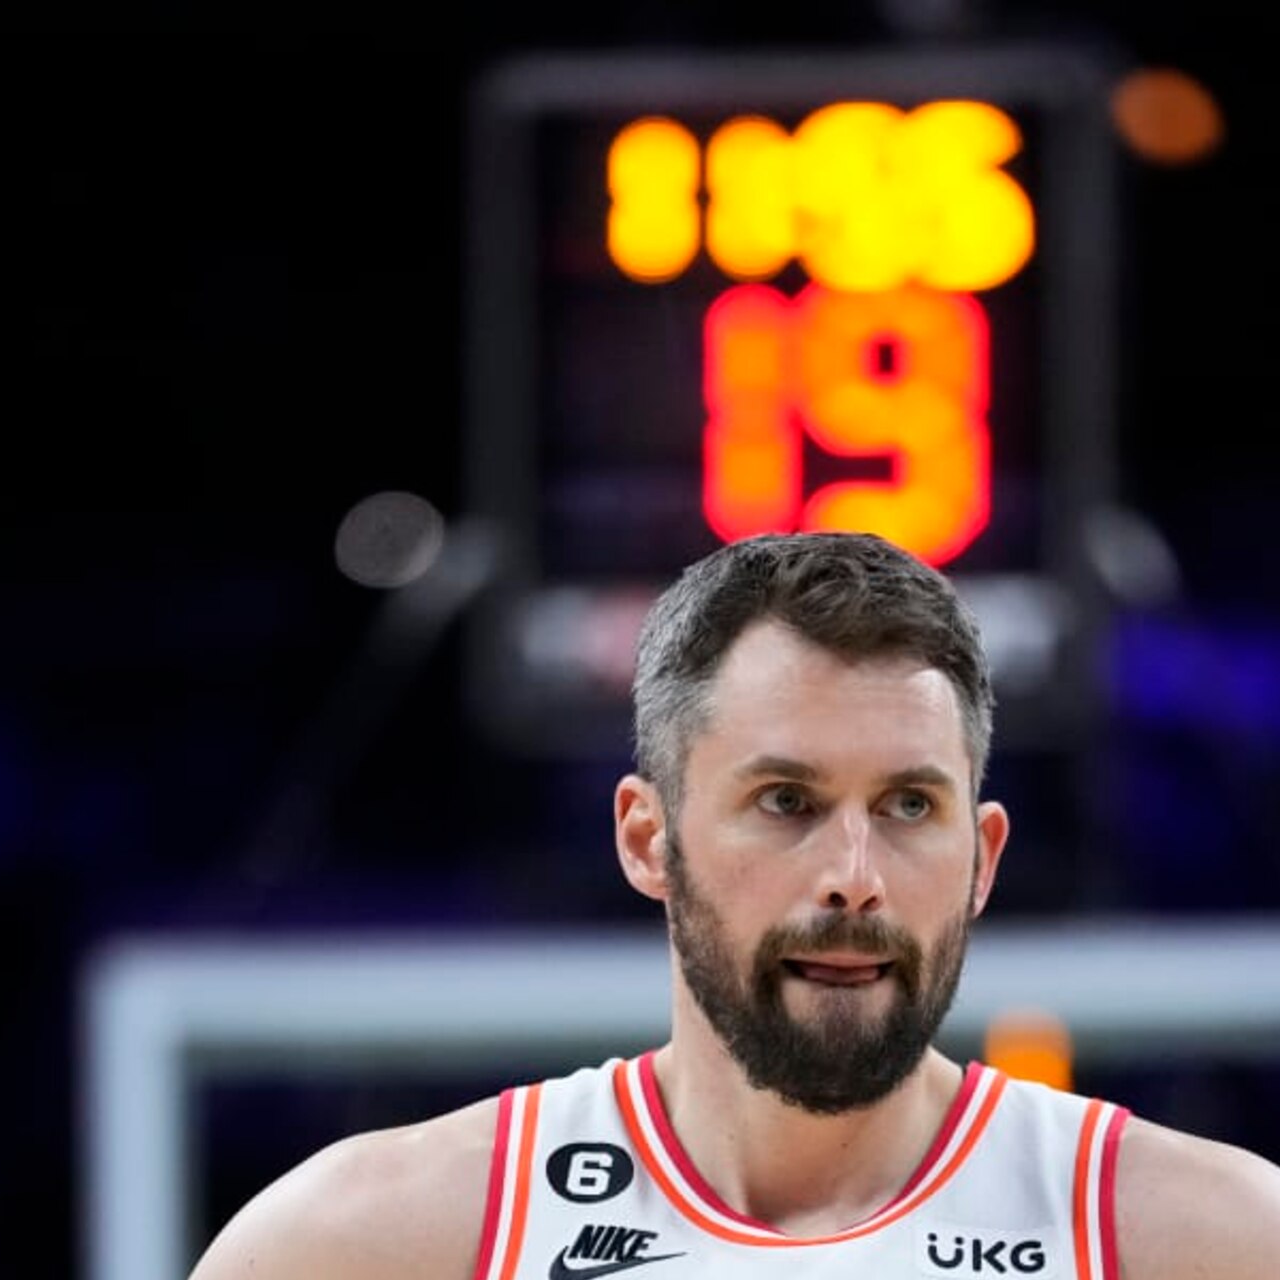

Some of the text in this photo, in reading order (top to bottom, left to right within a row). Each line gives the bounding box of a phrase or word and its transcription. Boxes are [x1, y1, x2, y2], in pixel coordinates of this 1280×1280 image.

[703, 283, 991, 568] 19
[566, 1151, 613, 1196] 6
[568, 1224, 659, 1263] NIKE
